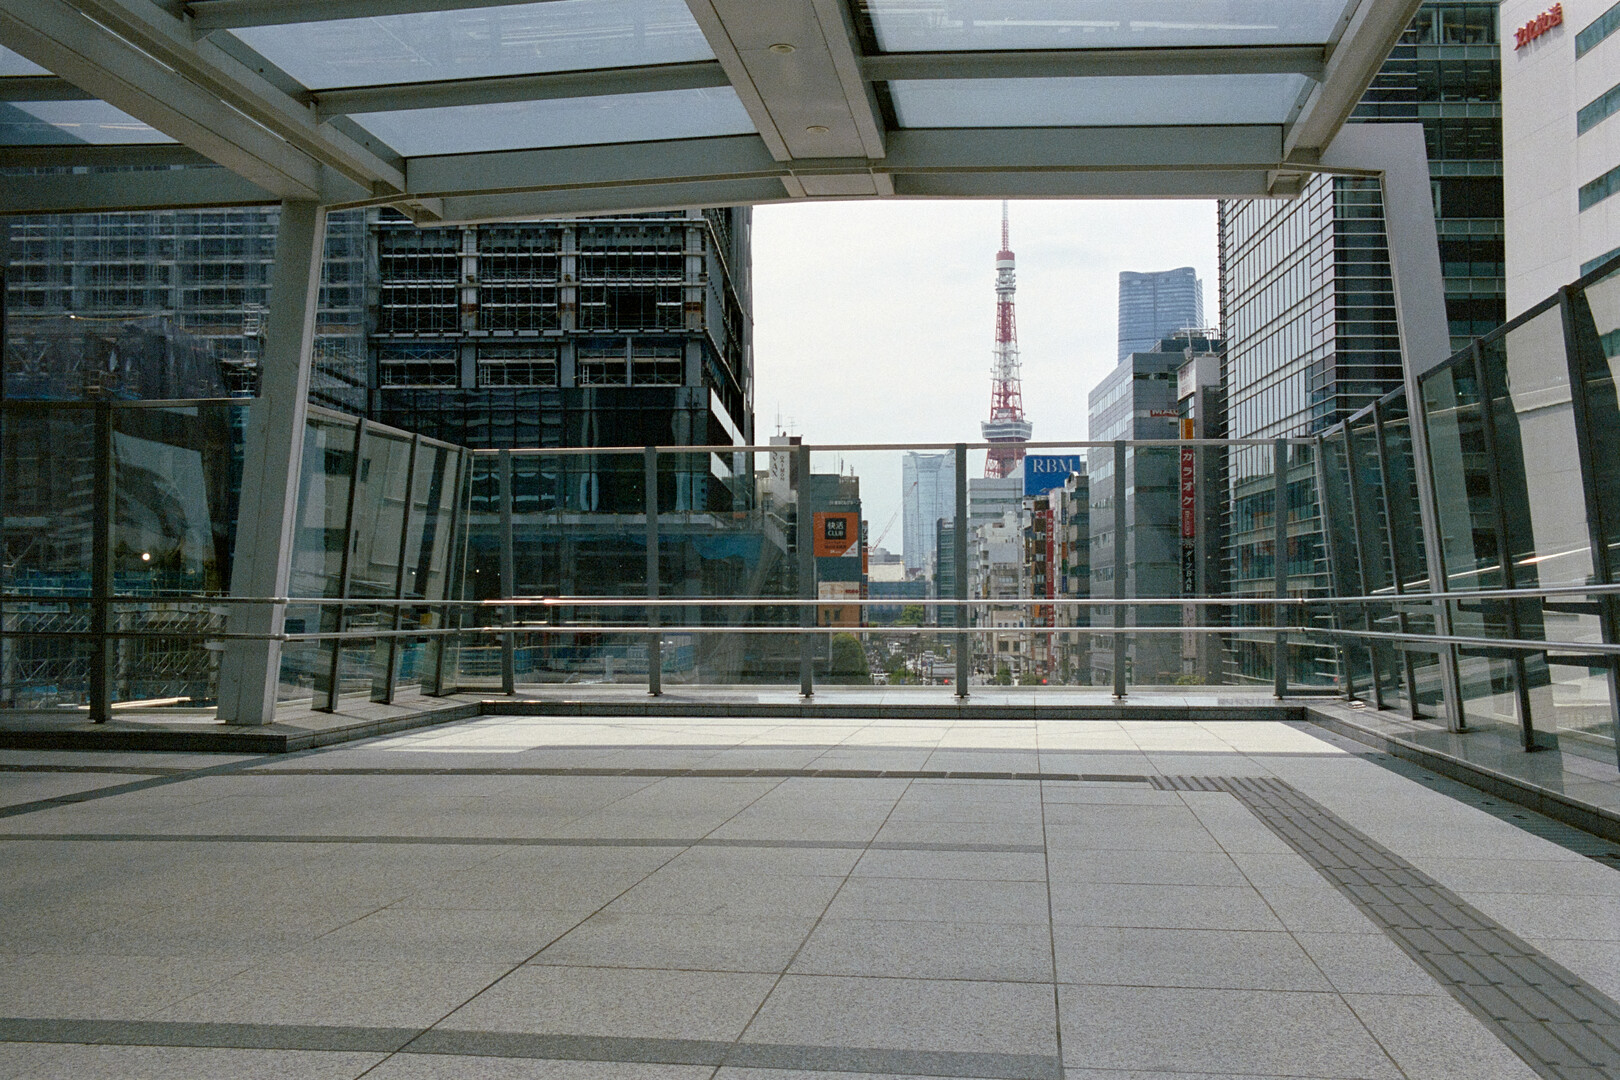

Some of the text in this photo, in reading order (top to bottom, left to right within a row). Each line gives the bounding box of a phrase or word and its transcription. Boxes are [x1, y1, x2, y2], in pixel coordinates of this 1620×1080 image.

[1033, 459, 1073, 473] RBM
[1183, 453, 1193, 506] カラオケ
[828, 521, 844, 530] 快活
